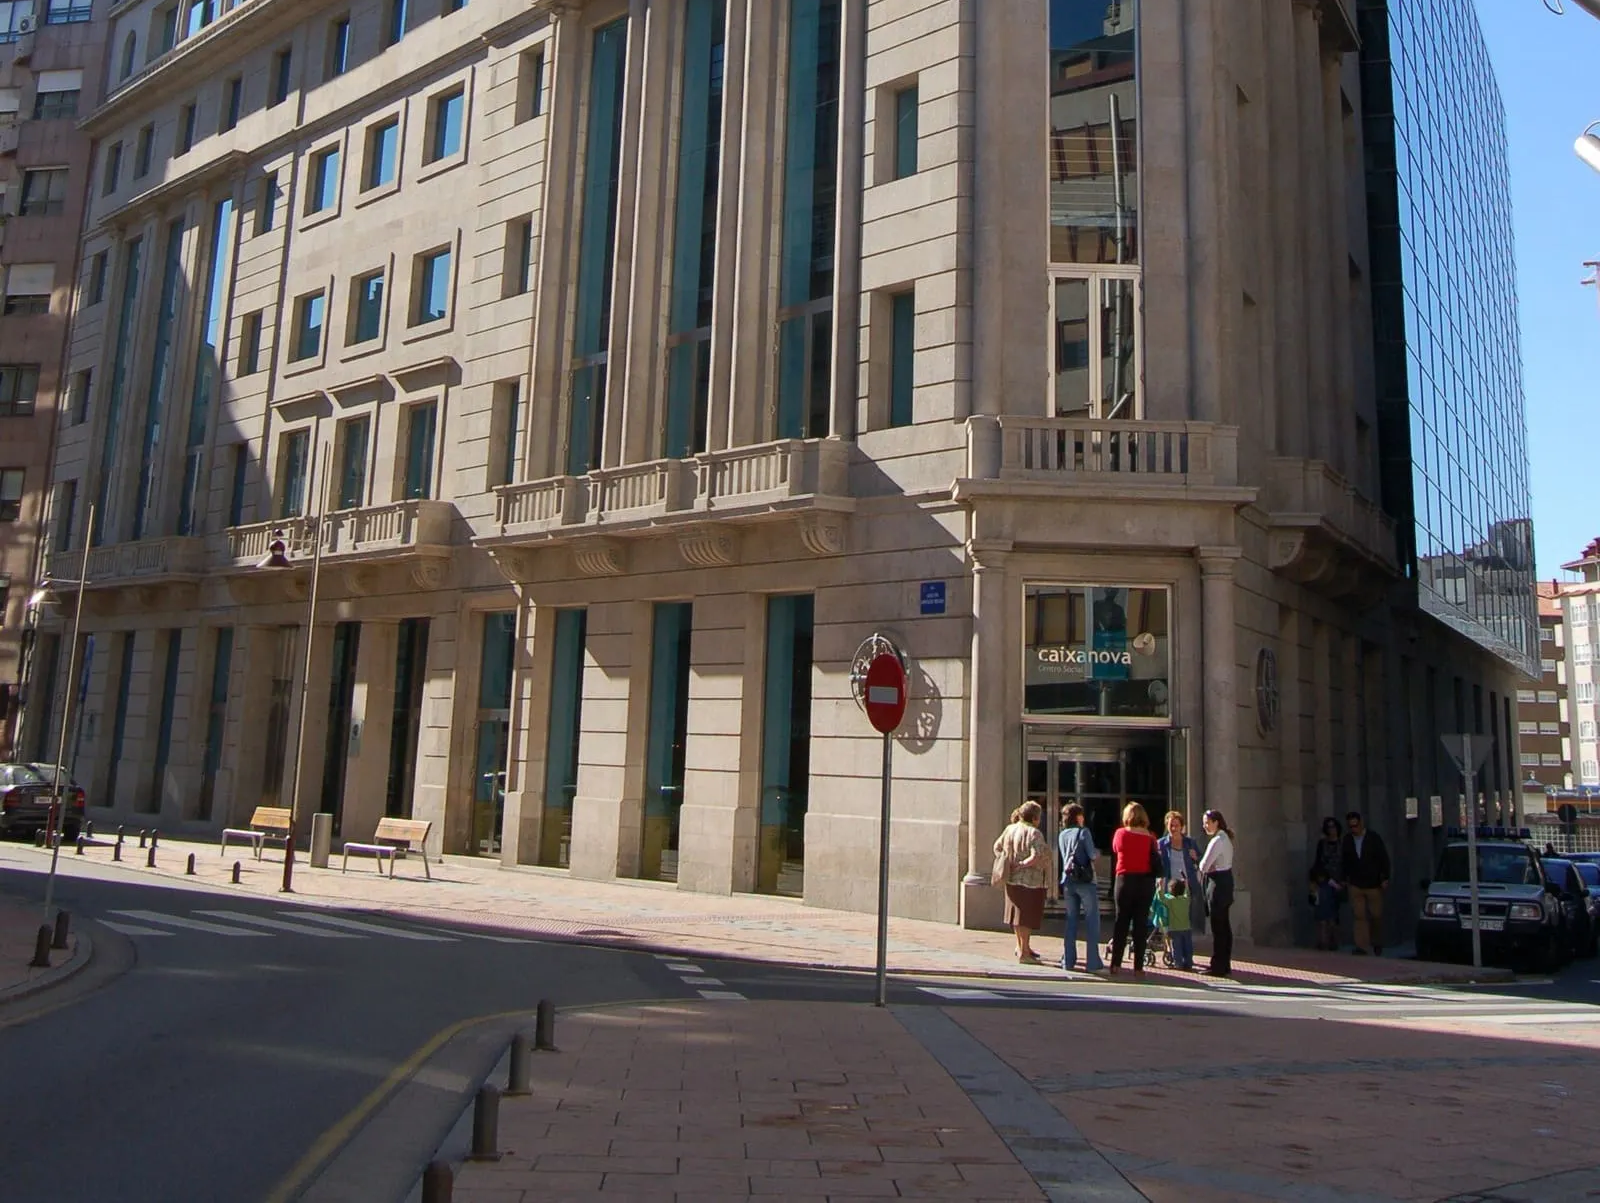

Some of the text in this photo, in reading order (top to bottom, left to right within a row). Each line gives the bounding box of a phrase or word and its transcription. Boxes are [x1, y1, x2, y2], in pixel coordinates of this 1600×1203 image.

[1038, 646, 1132, 665] caixanova
[1038, 665, 1084, 674] Centro Social
